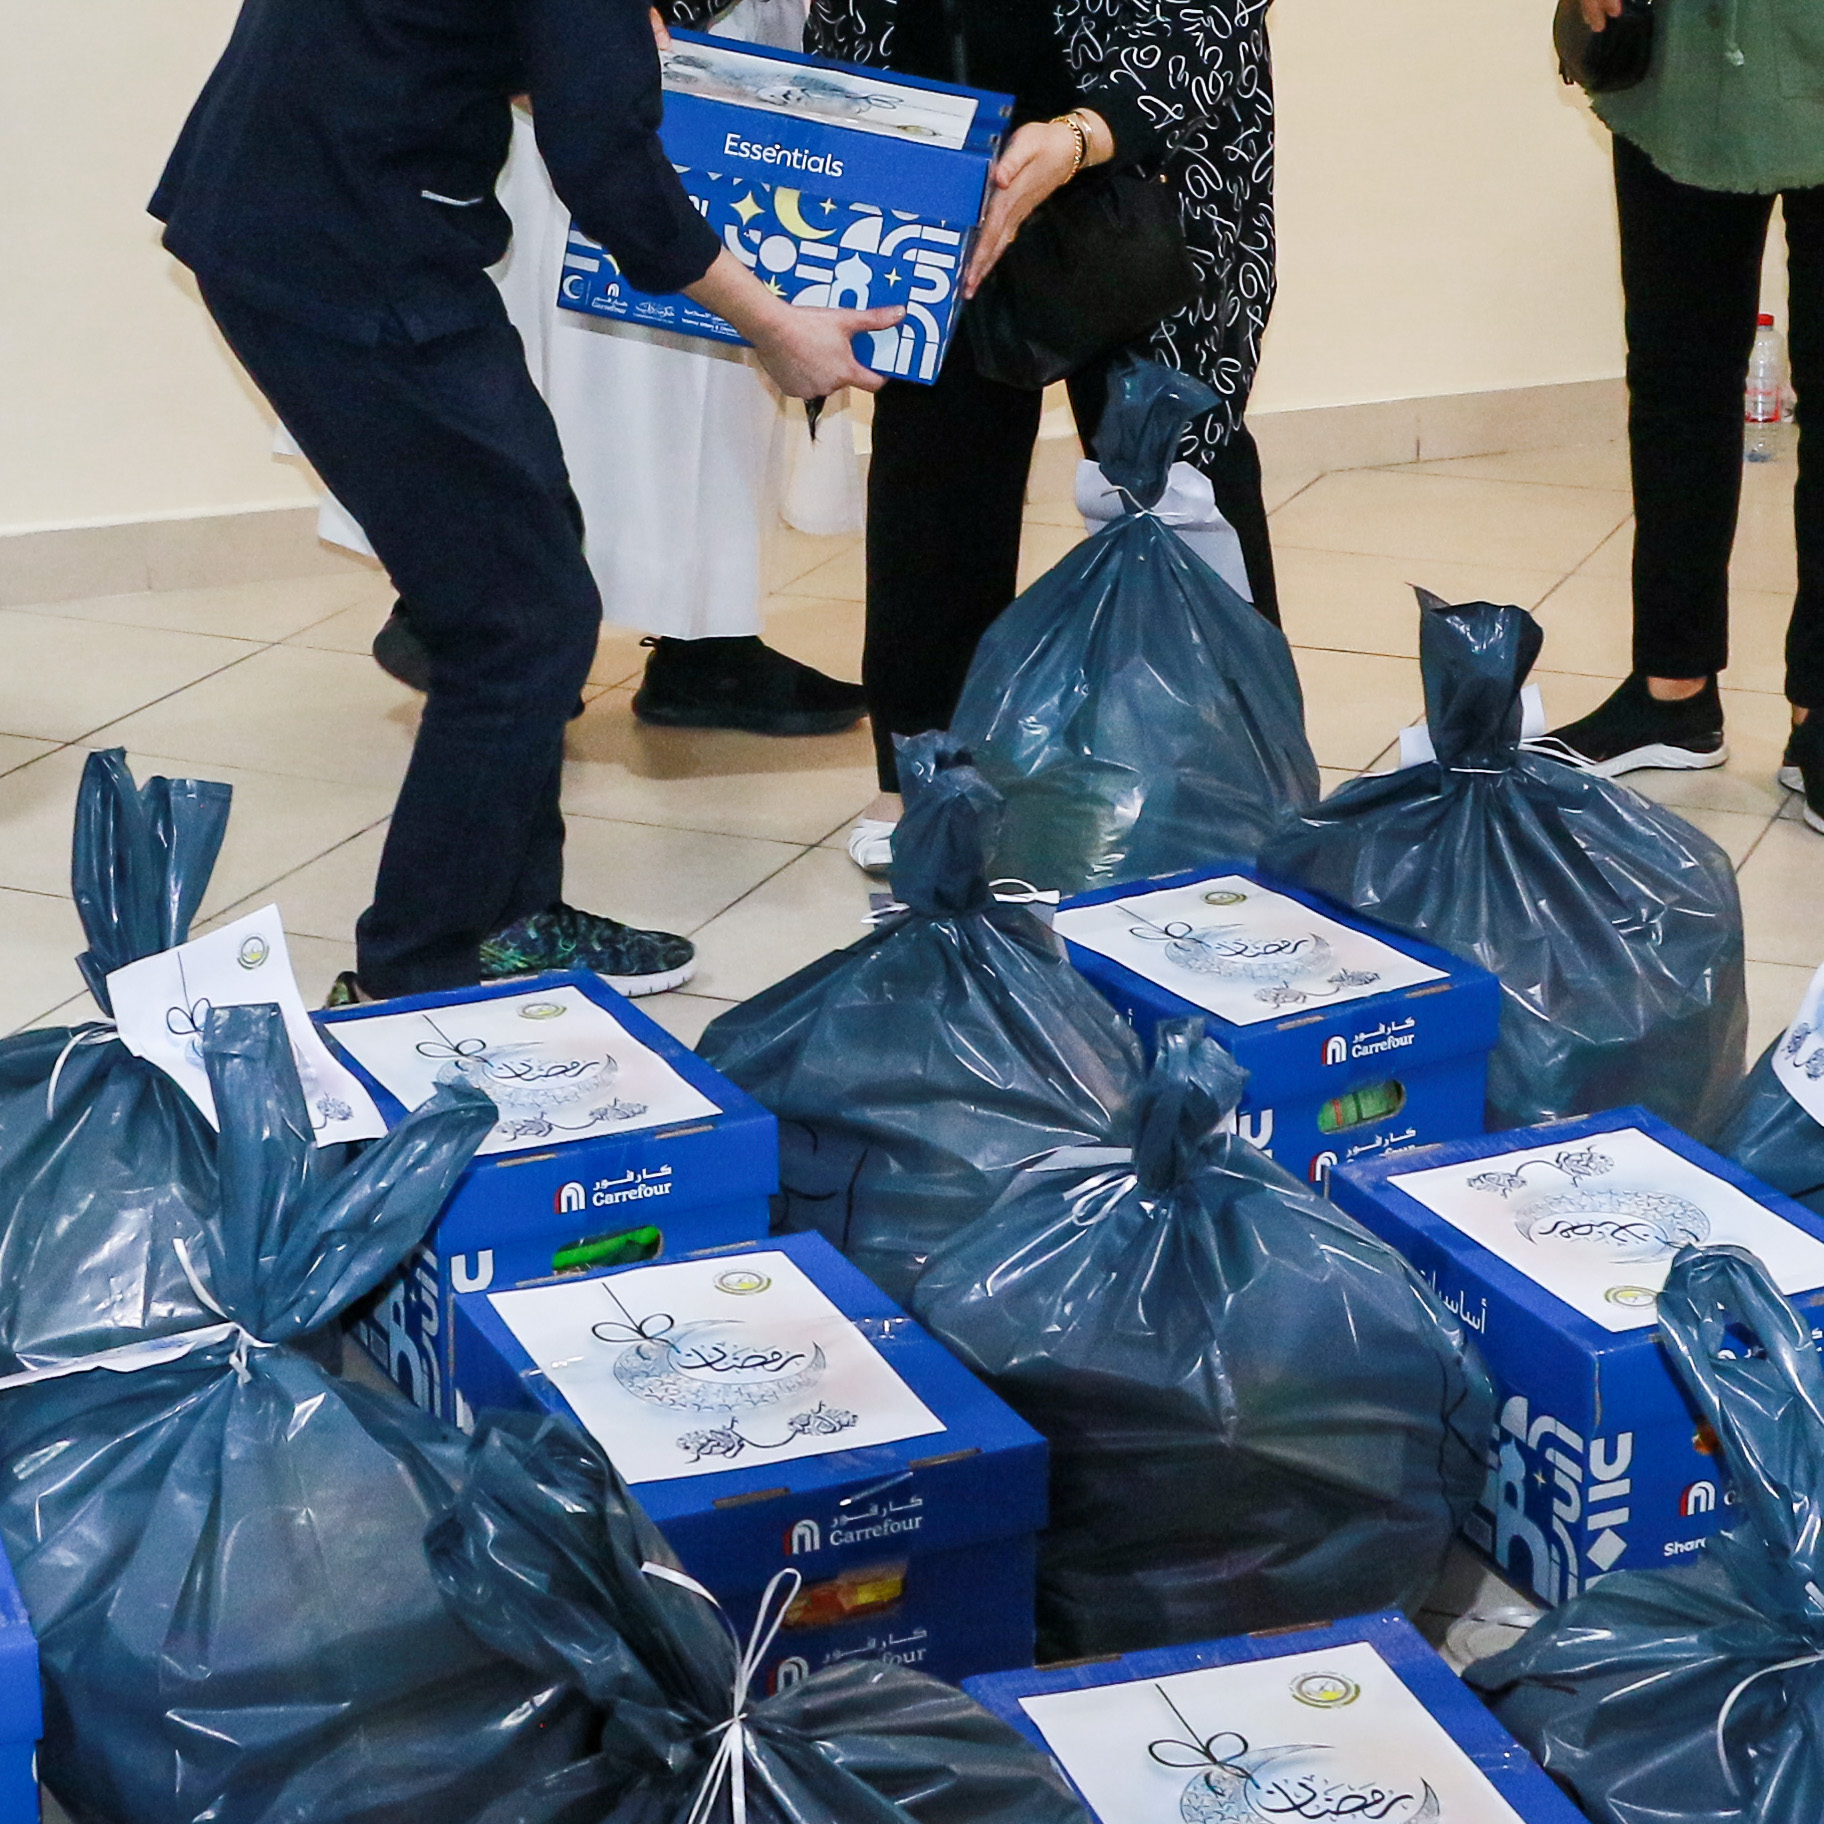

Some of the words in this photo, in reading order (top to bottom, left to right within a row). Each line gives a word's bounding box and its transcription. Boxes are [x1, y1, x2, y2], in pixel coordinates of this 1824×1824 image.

[723, 132, 845, 177] Essentials
[1352, 1016, 1416, 1044] كارفور
[1351, 1034, 1416, 1059] Carrefour
[592, 1163, 673, 1191] كارفور
[591, 1181, 673, 1208] Carrefour
[830, 1494, 923, 1528] كارفور
[829, 1515, 924, 1547] Carrefour
